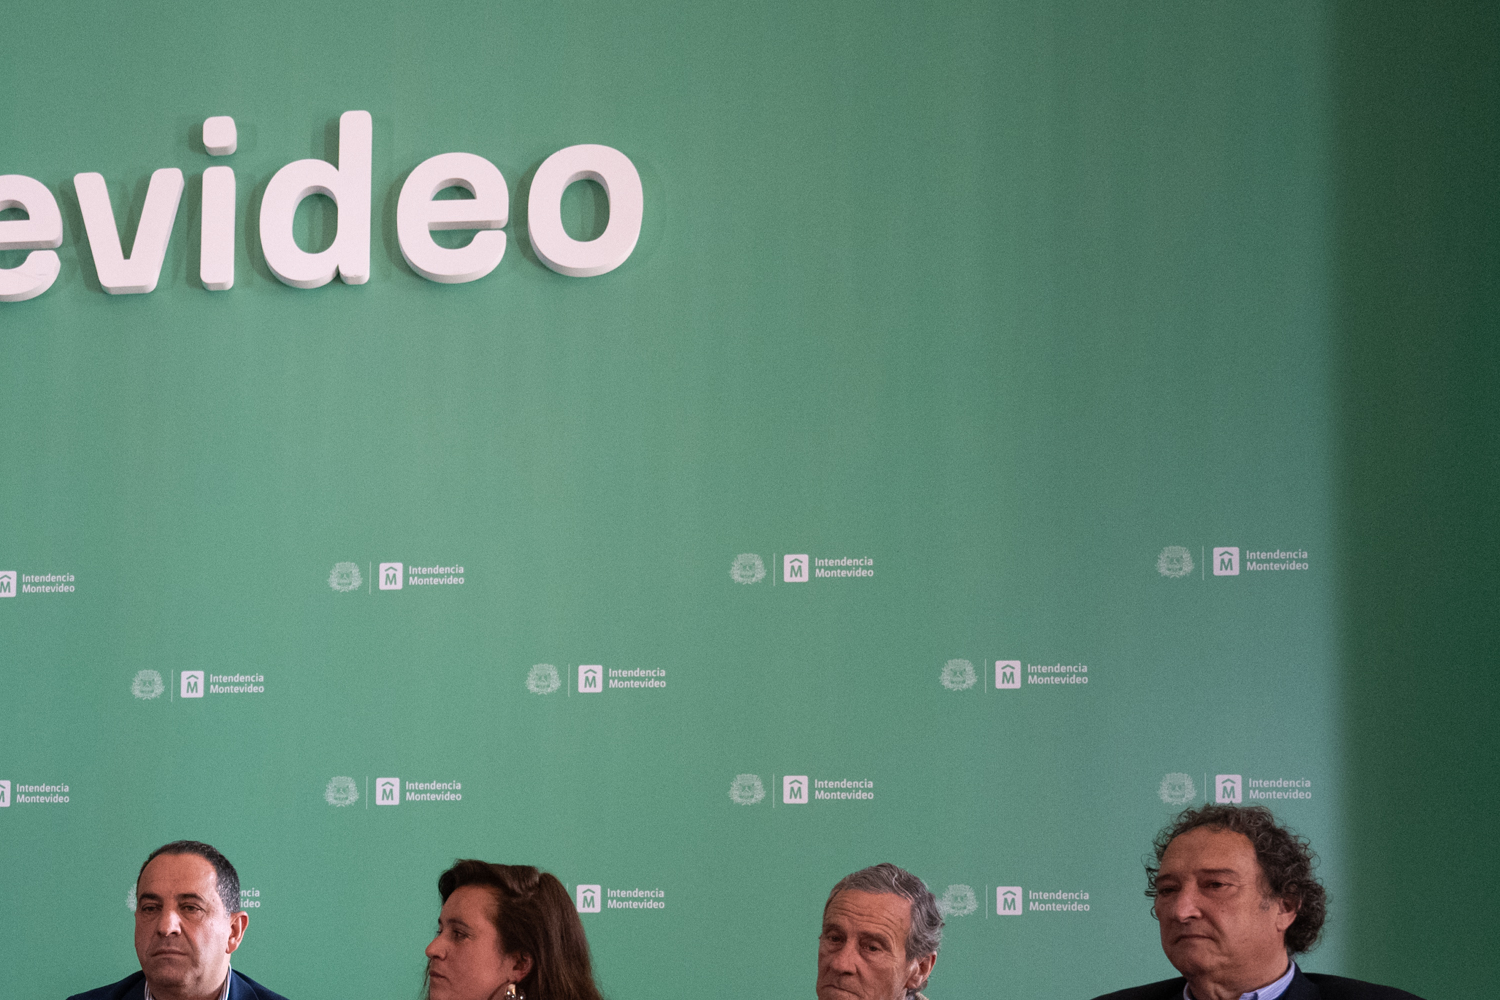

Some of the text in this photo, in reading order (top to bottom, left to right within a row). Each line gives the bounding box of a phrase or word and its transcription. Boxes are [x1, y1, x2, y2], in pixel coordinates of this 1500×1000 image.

[1246, 549, 1309, 560] Intendencia
[814, 556, 874, 567] Intendencia
[1246, 560, 1309, 571] Montevideo
[408, 564, 465, 575] Intendencia
[814, 567, 875, 578] Montevideo
[21, 573, 75, 583] Intendencia
[408, 575, 465, 586] Montevideo
[21, 583, 76, 593] Montevideo
[608, 667, 666, 678] Intendencia
[1027, 663, 1088, 674] Intendencia
[209, 673, 265, 683] Intendencia
[608, 678, 667, 689] Montevideo
[1027, 674, 1089, 685] Montevideo
[209, 683, 265, 694] Montevideo
[16, 783, 70, 793] Intendencia
[405, 780, 462, 791] Intendencia
[814, 778, 874, 789] Intendencia
[1248, 777, 1312, 788] Intendencia
[16, 793, 70, 804] Montevideo
[405, 791, 463, 802] Montevideo
[814, 789, 875, 800] Montevideo
[1248, 789, 1312, 800] Montevideo
[607, 887, 665, 898] Intendencia
[1028, 889, 1090, 900] Intendencia
[607, 898, 666, 909] Montevideo
[1028, 901, 1091, 912] Montevideo
